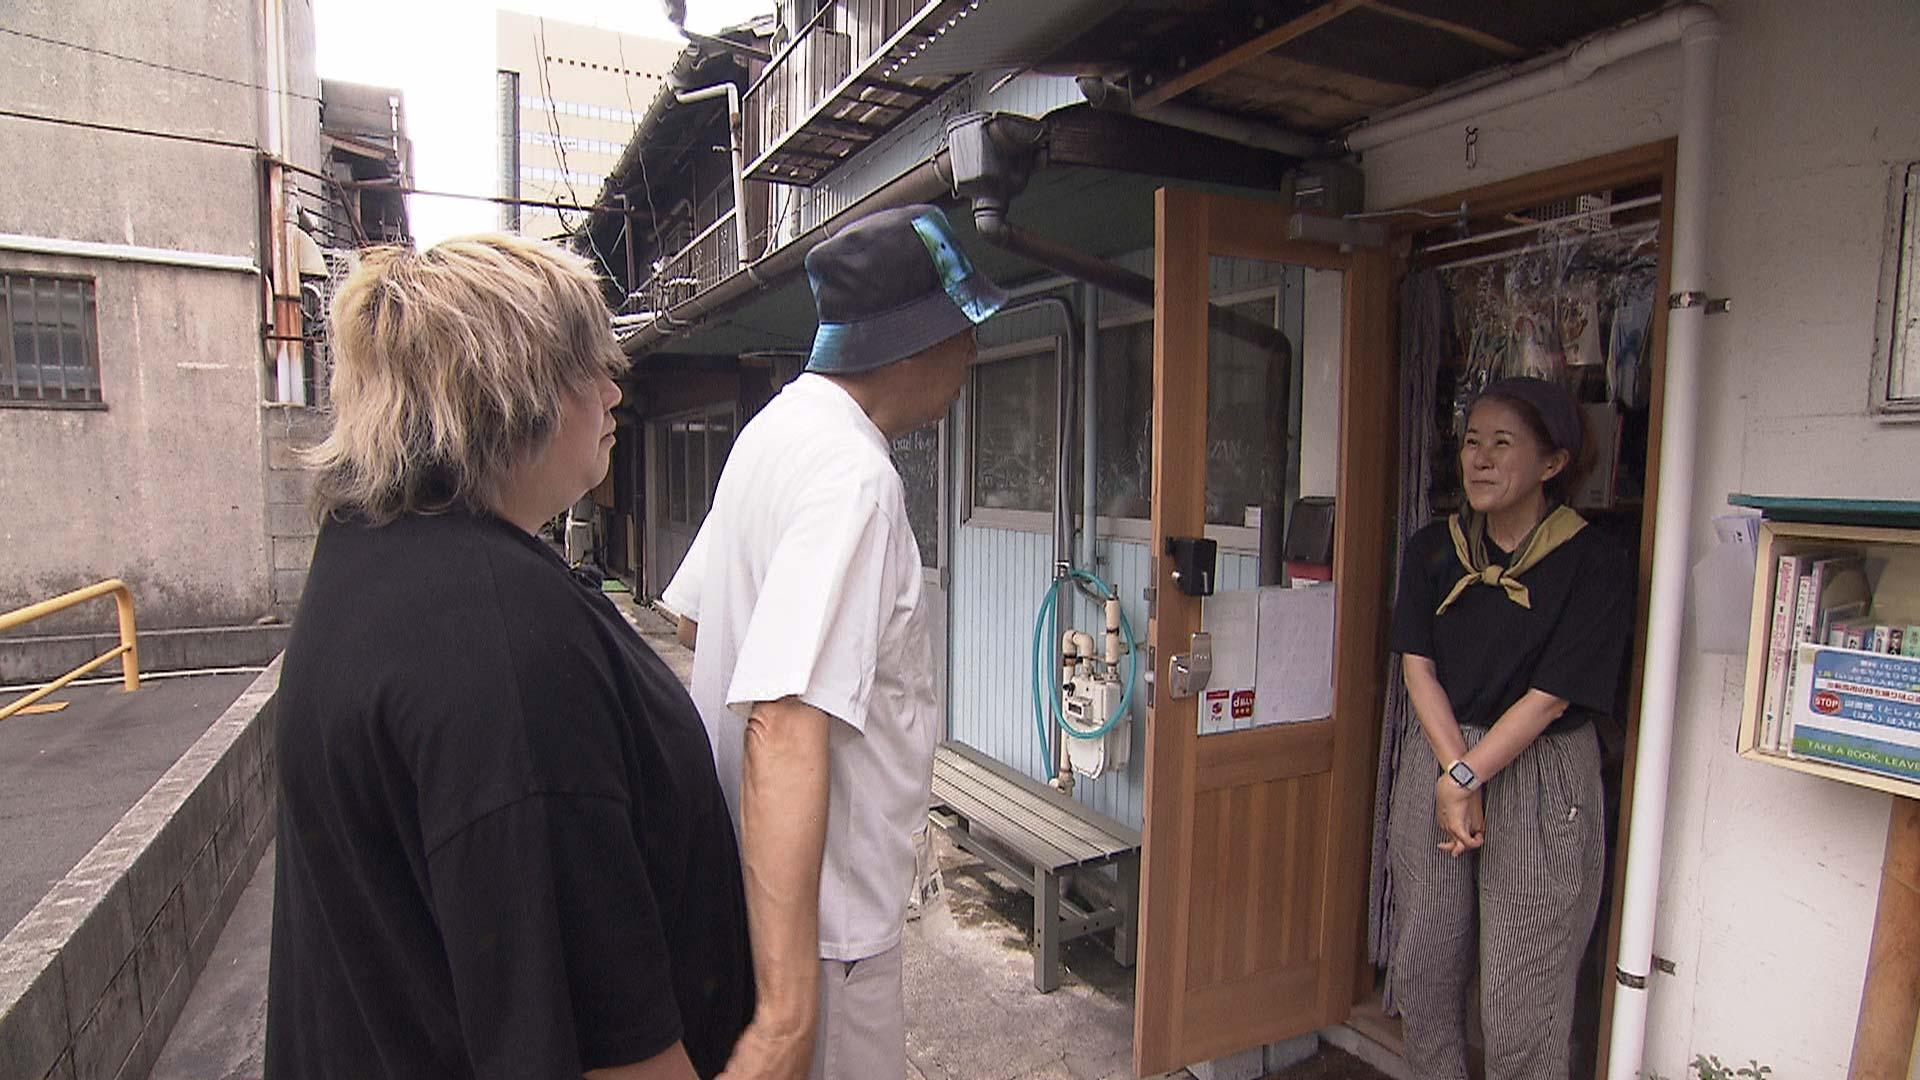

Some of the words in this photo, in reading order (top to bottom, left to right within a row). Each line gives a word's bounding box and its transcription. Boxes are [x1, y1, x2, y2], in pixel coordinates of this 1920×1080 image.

[1814, 698, 1839, 709] STOP
[1808, 741, 1832, 752] TAKE
[1836, 746, 1844, 754] A
